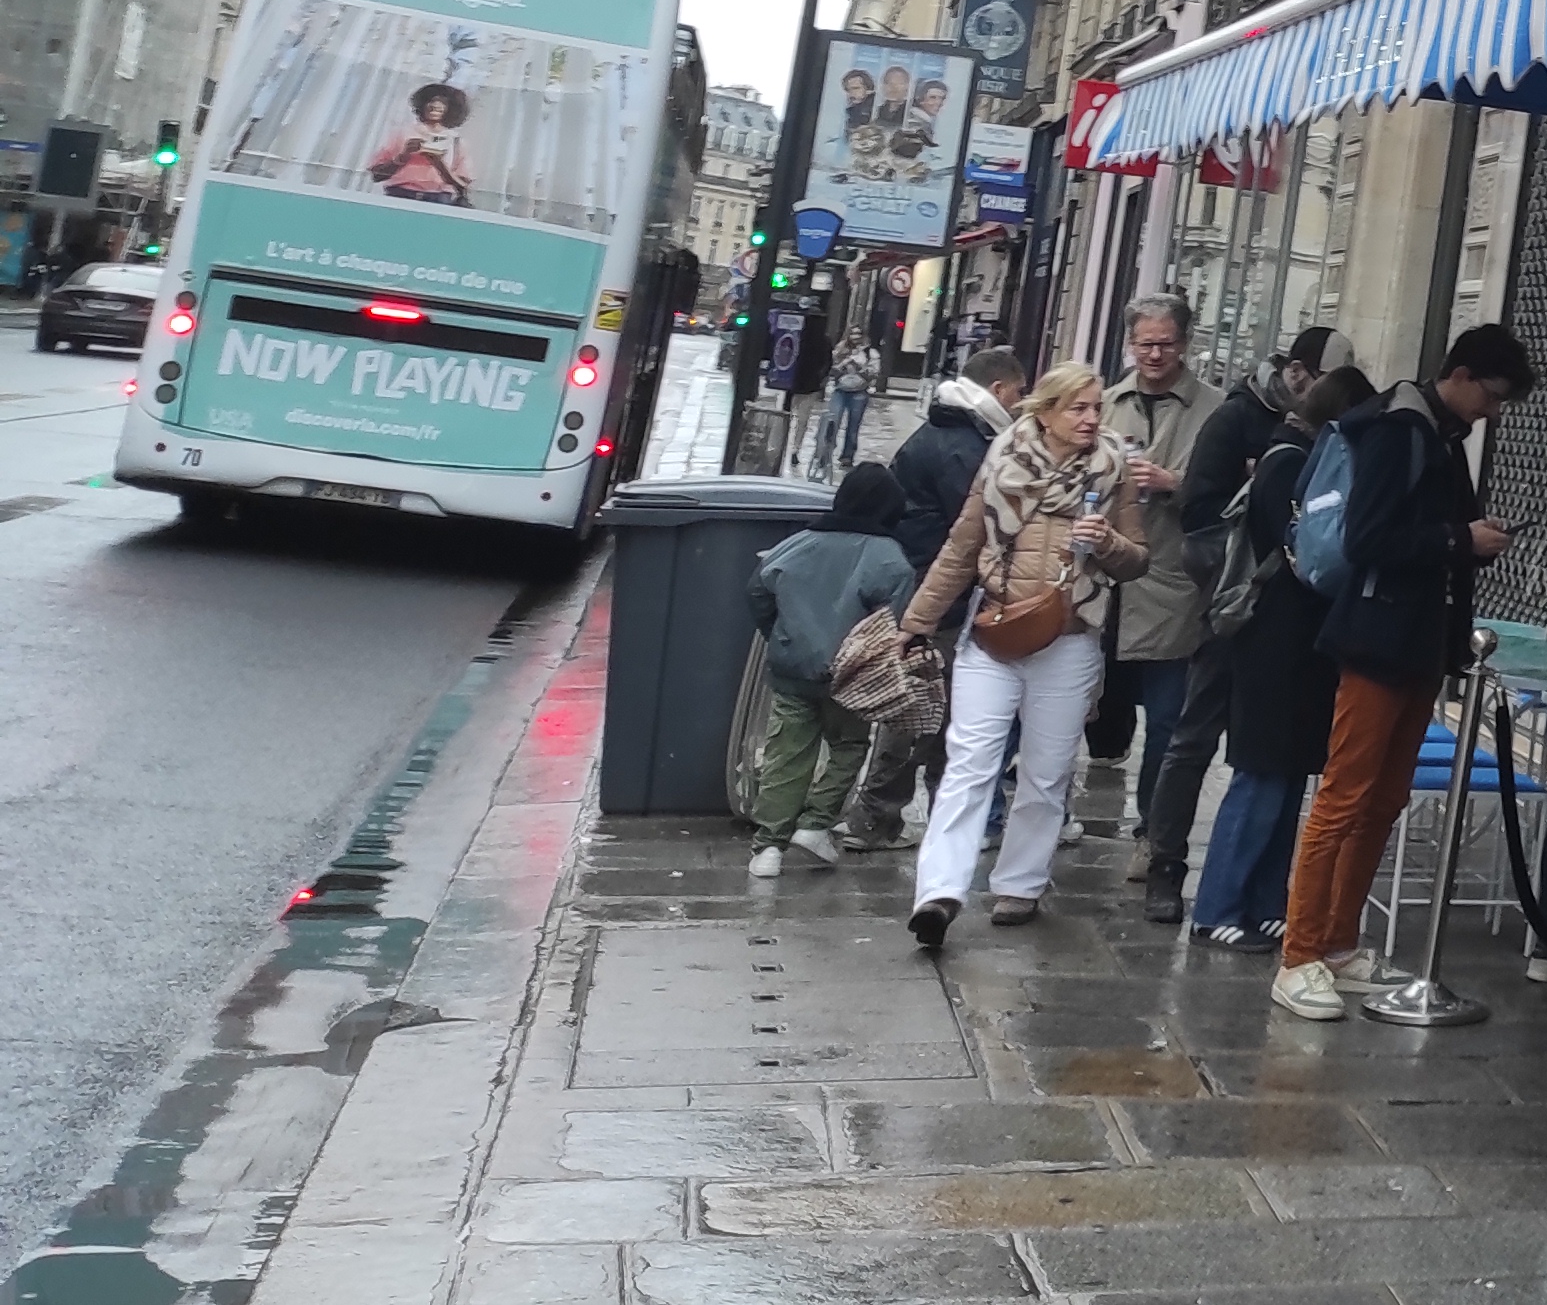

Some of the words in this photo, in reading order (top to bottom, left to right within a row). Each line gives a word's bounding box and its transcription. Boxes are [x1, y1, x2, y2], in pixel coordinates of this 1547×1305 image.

[266, 241, 315, 262] L'art
[318, 248, 333, 266] à
[336, 253, 410, 277] chaque
[413, 266, 457, 285] coin
[461, 271, 487, 289] de
[491, 278, 526, 295] rue
[217, 328, 348, 385] NOW
[351, 349, 537, 411] PLAYING
[181, 447, 203, 467] 70
